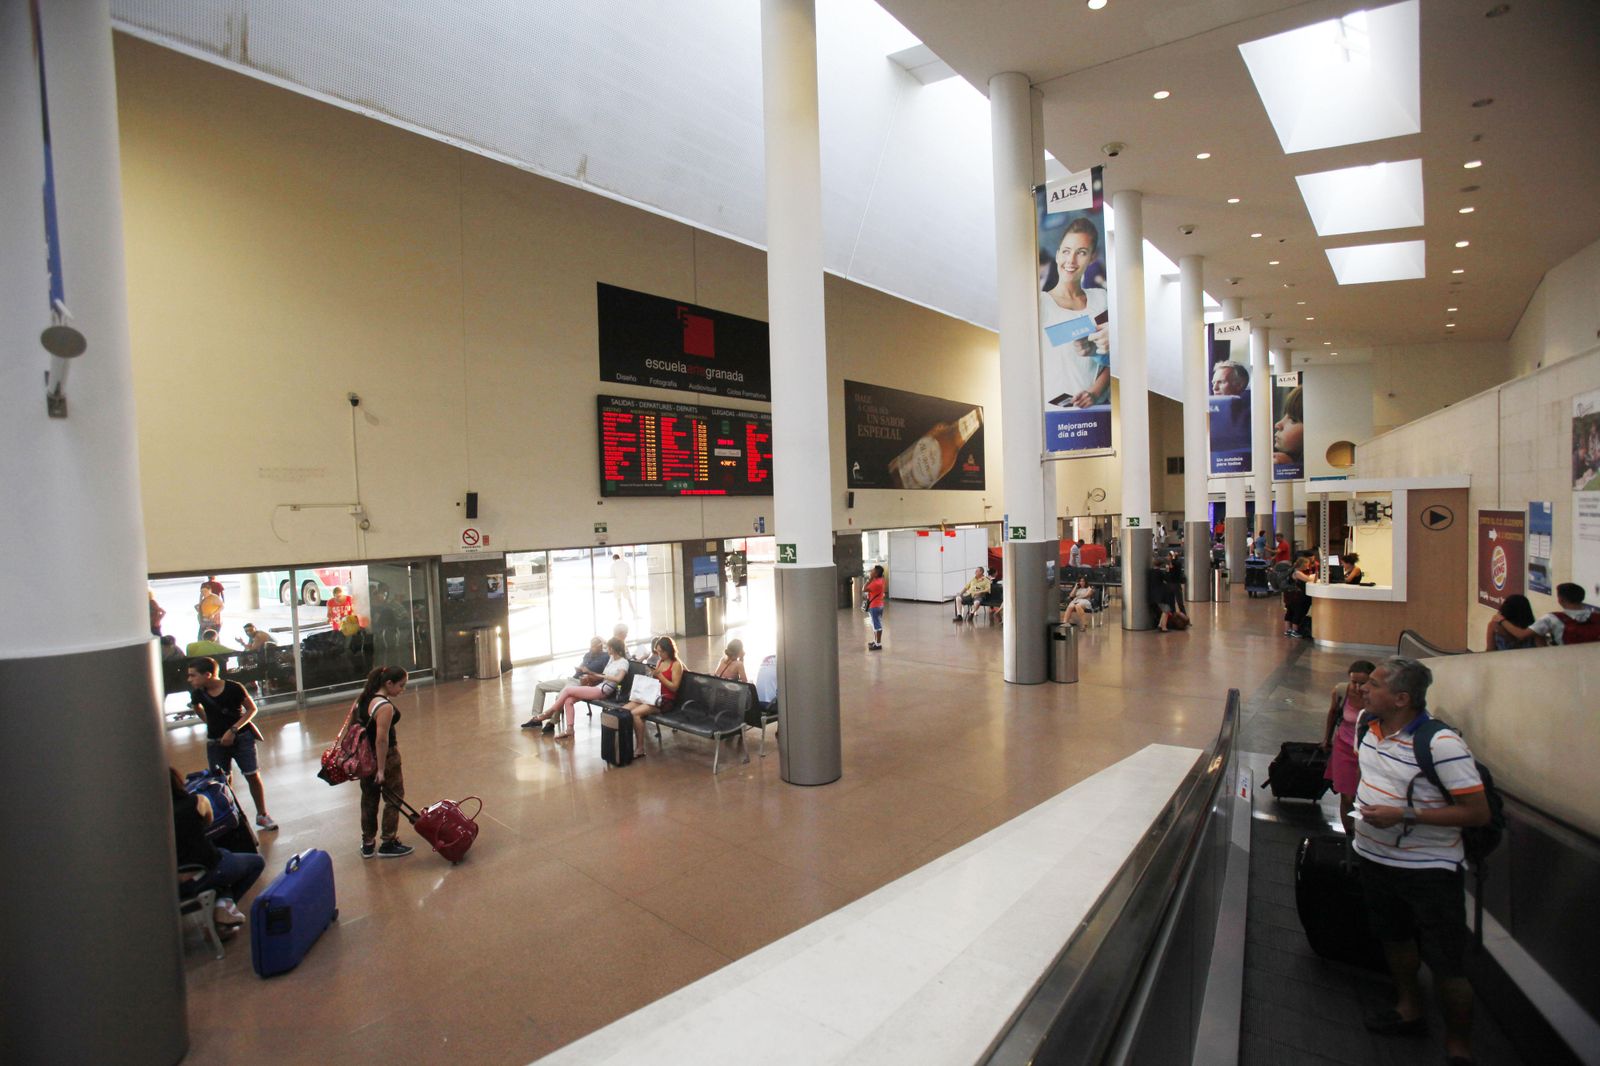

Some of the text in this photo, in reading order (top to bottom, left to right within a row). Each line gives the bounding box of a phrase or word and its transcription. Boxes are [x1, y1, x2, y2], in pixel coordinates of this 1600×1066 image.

[1050, 182, 1088, 203] ALSA
[1217, 325, 1241, 335] ALSA
[611, 399, 635, 408] SALIDAS
[639, 401, 673, 411] DEPARTURES
[712, 409, 735, 417] LLEGADAS
[867, 414, 906, 429] UN SABOR
[1058, 422, 1097, 431] Mejoramos
[858, 424, 902, 441] ESPECIAL
[1057, 431, 1069, 439] día
[1076, 429, 1088, 437] día
